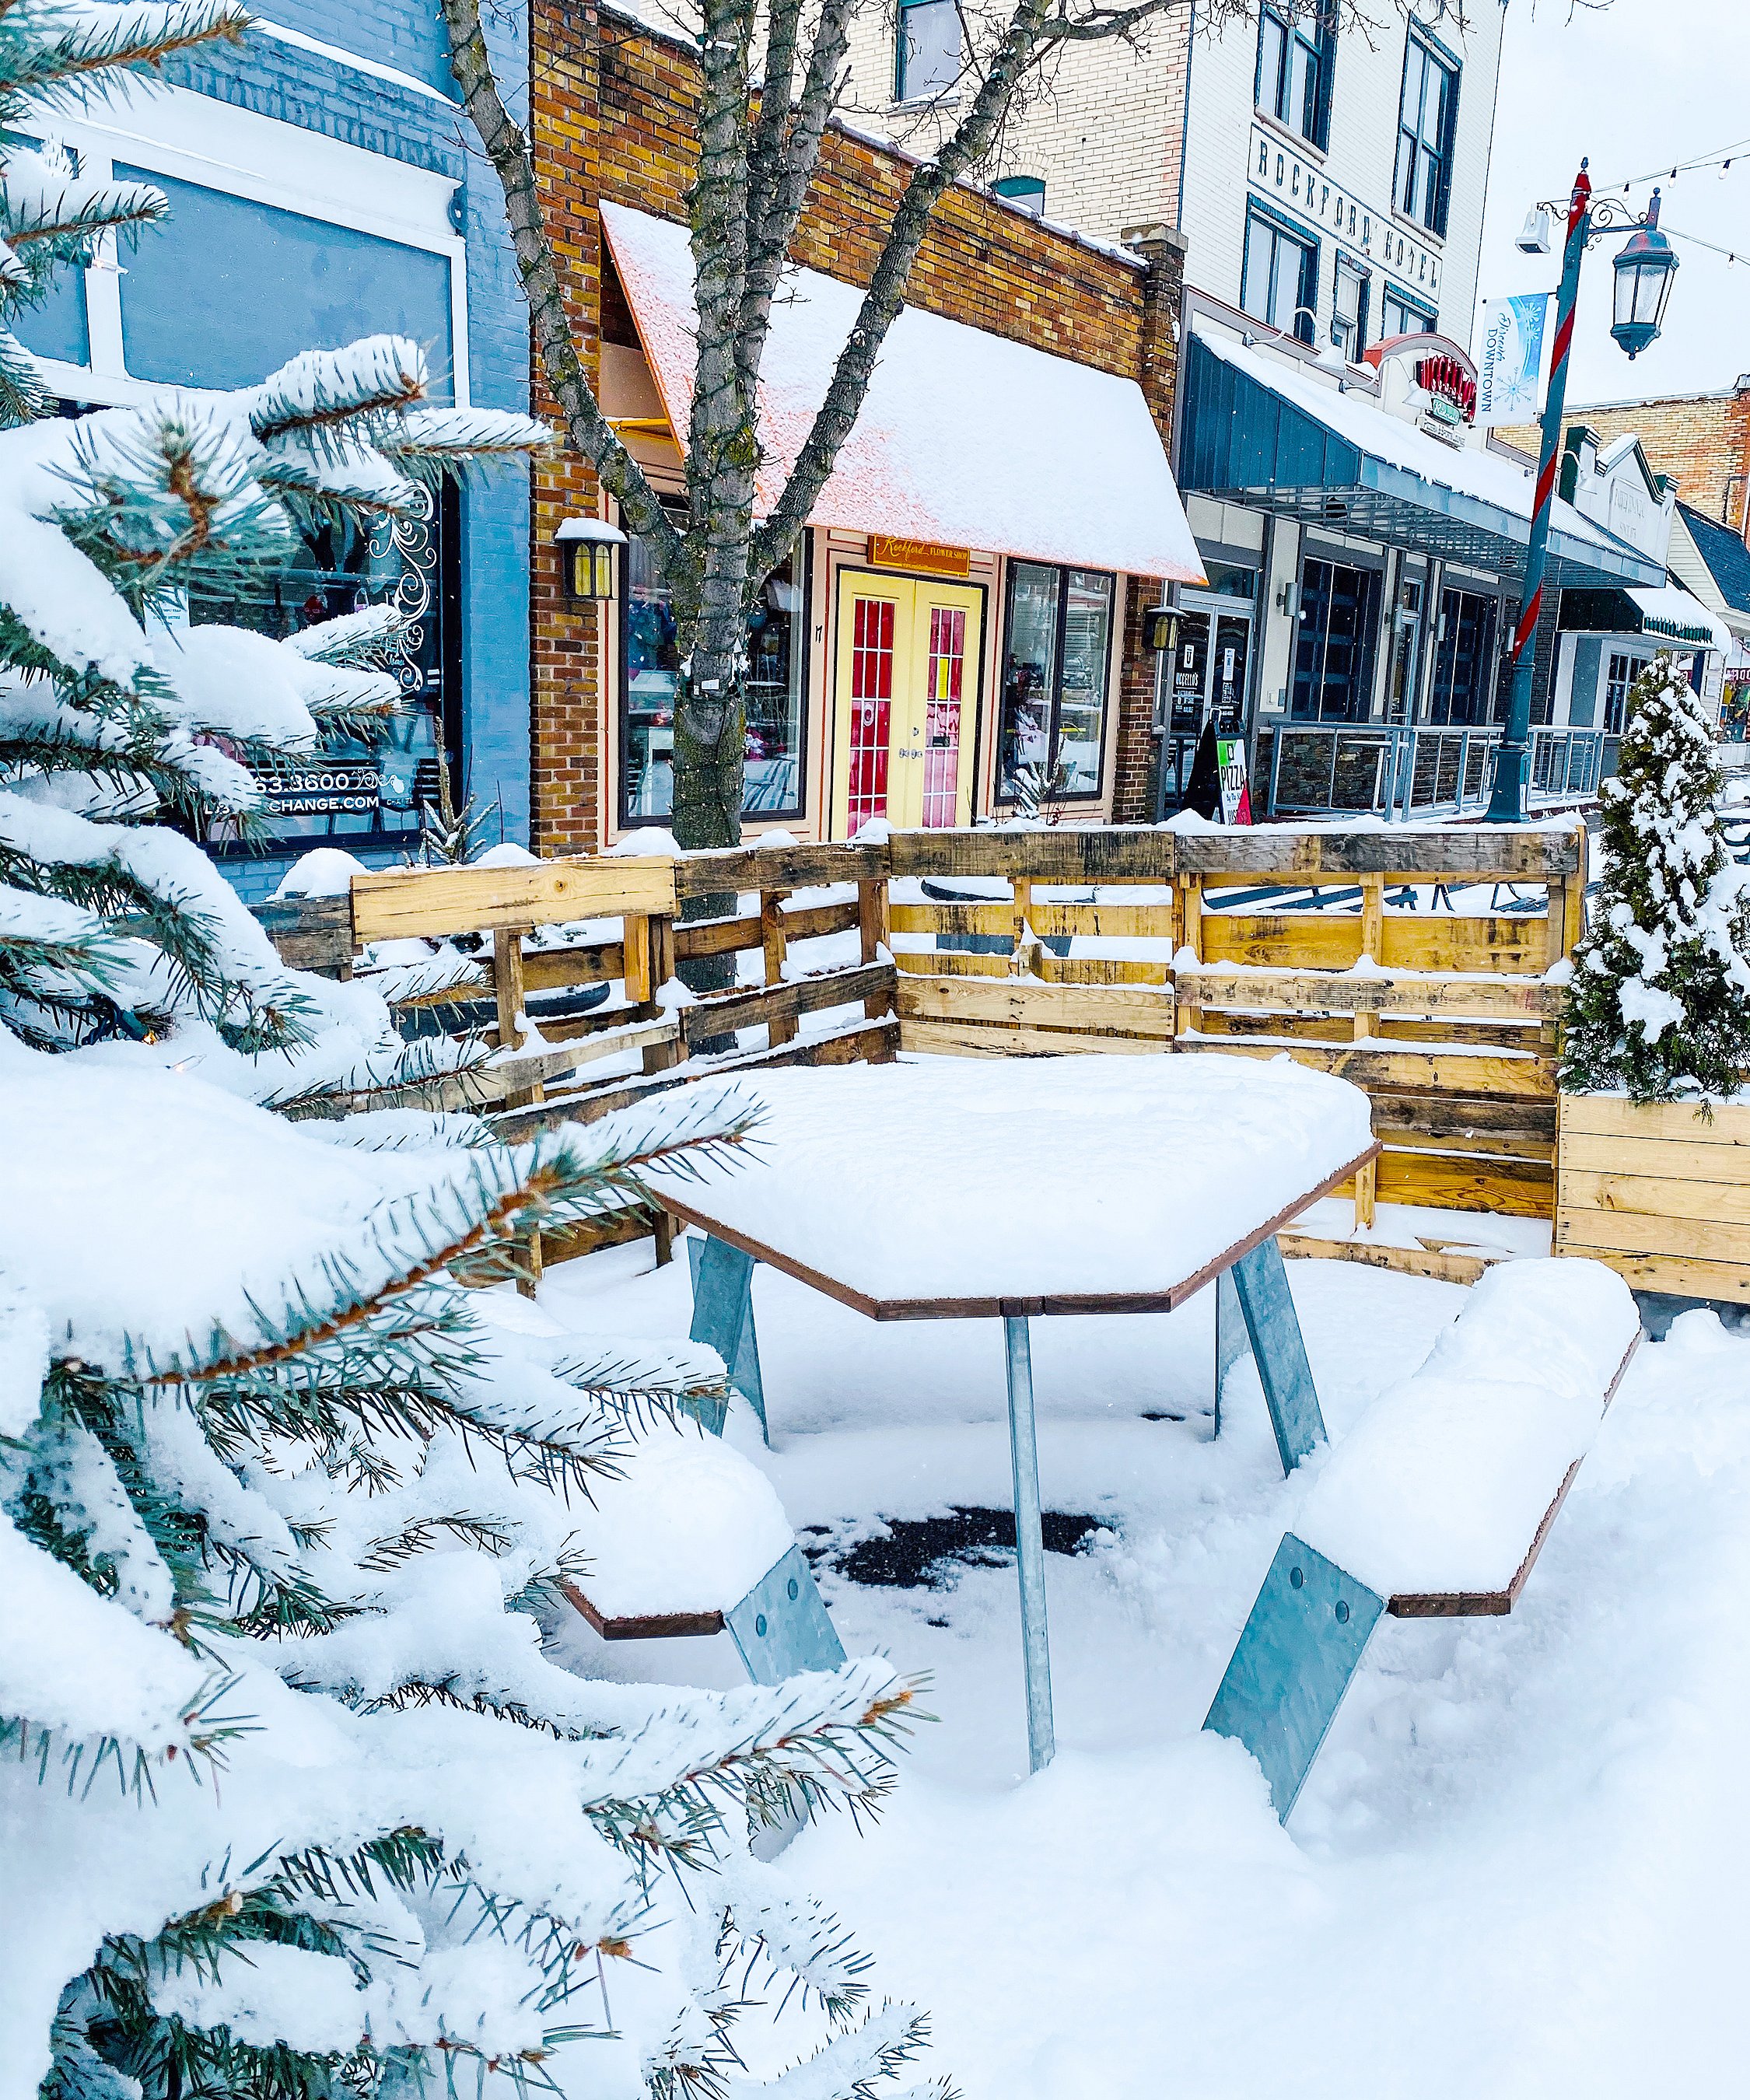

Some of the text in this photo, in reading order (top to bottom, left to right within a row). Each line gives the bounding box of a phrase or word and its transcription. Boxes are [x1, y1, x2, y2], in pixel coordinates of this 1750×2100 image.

[1258, 139, 1437, 289] ROCKFORD HOTEL
[1496, 312, 1511, 362] Discover
[1481, 328, 1498, 412] DOWNTOWN
[877, 536, 968, 562] Rockford FLOWER SHOP
[1175, 672, 1199, 687] UCCELLO'S
[1220, 765, 1244, 792] PIZZA
